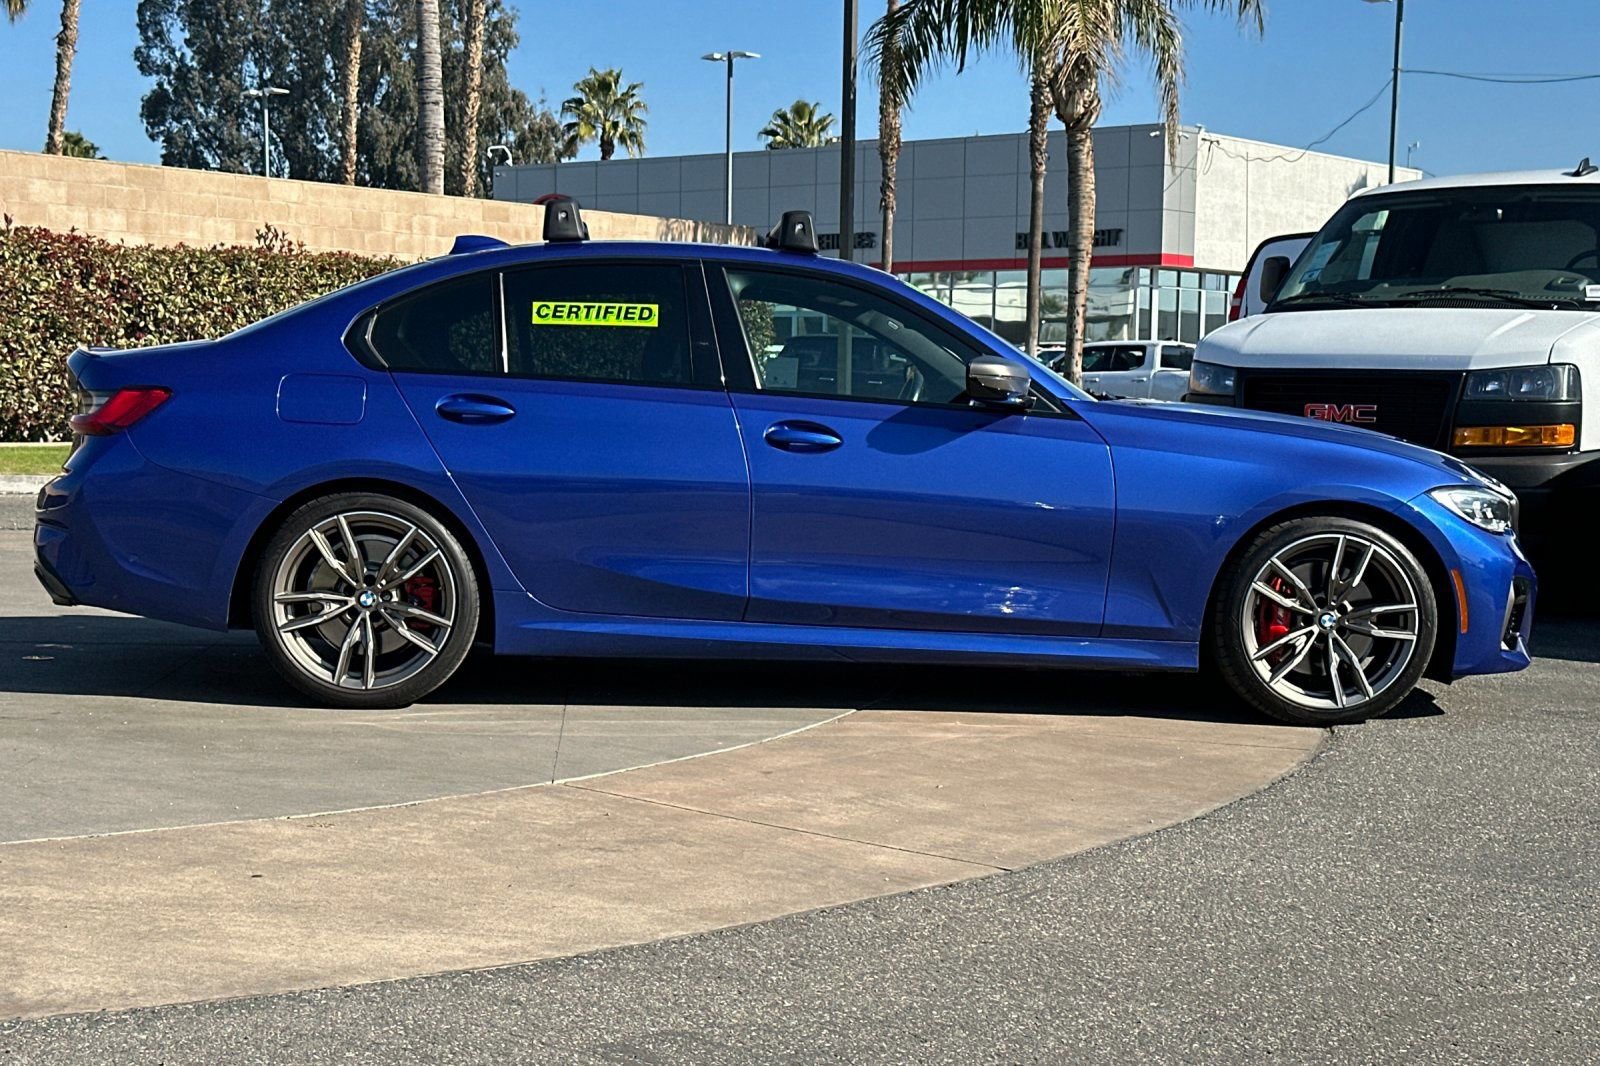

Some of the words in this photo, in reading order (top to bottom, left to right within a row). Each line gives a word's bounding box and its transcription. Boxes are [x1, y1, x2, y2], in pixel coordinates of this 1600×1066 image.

[816, 232, 877, 250] EHIES
[1016, 232, 1052, 249] BL
[1052, 228, 1124, 249] WGHT
[536, 304, 654, 321] CERTIFIED
[1304, 404, 1377, 423] GMC
